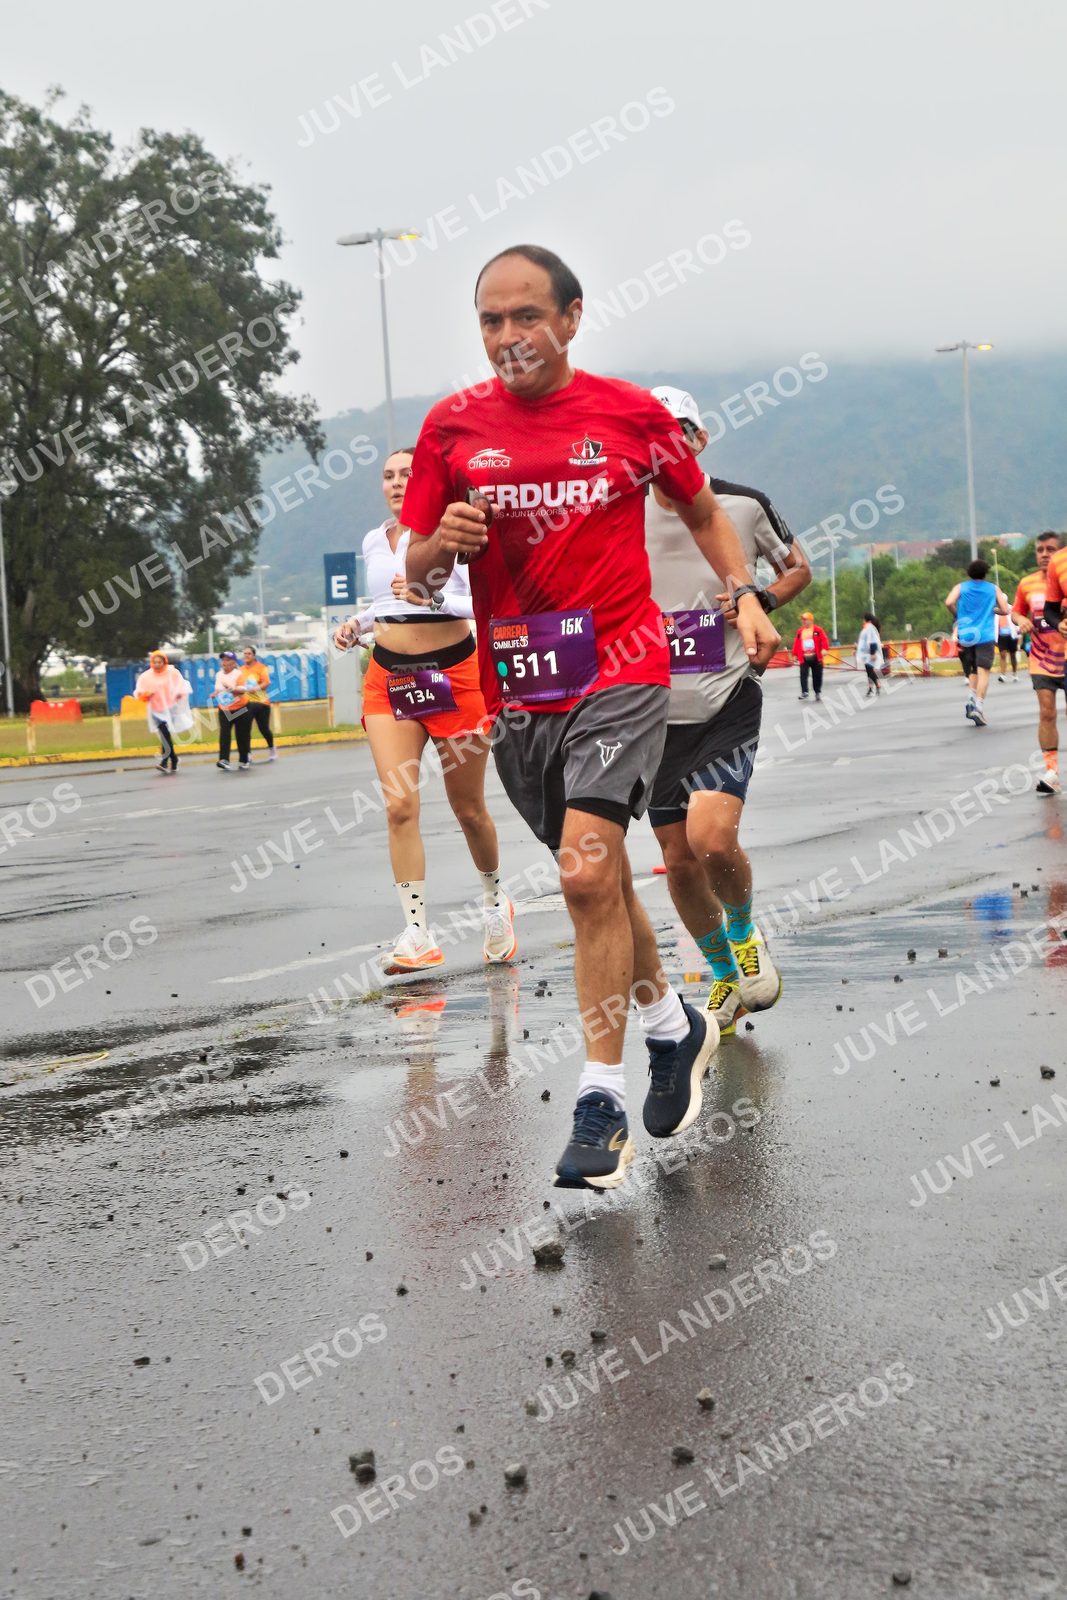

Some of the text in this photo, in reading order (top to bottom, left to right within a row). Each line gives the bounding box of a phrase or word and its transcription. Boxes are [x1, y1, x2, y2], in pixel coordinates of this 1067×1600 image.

[468, 456, 510, 470] atletica
[510, 508, 568, 519] JUNTEADORES
[331, 575, 349, 599] E
[493, 624, 528, 640] CARRERA
[513, 650, 558, 678] 511
[405, 688, 435, 704] 134
